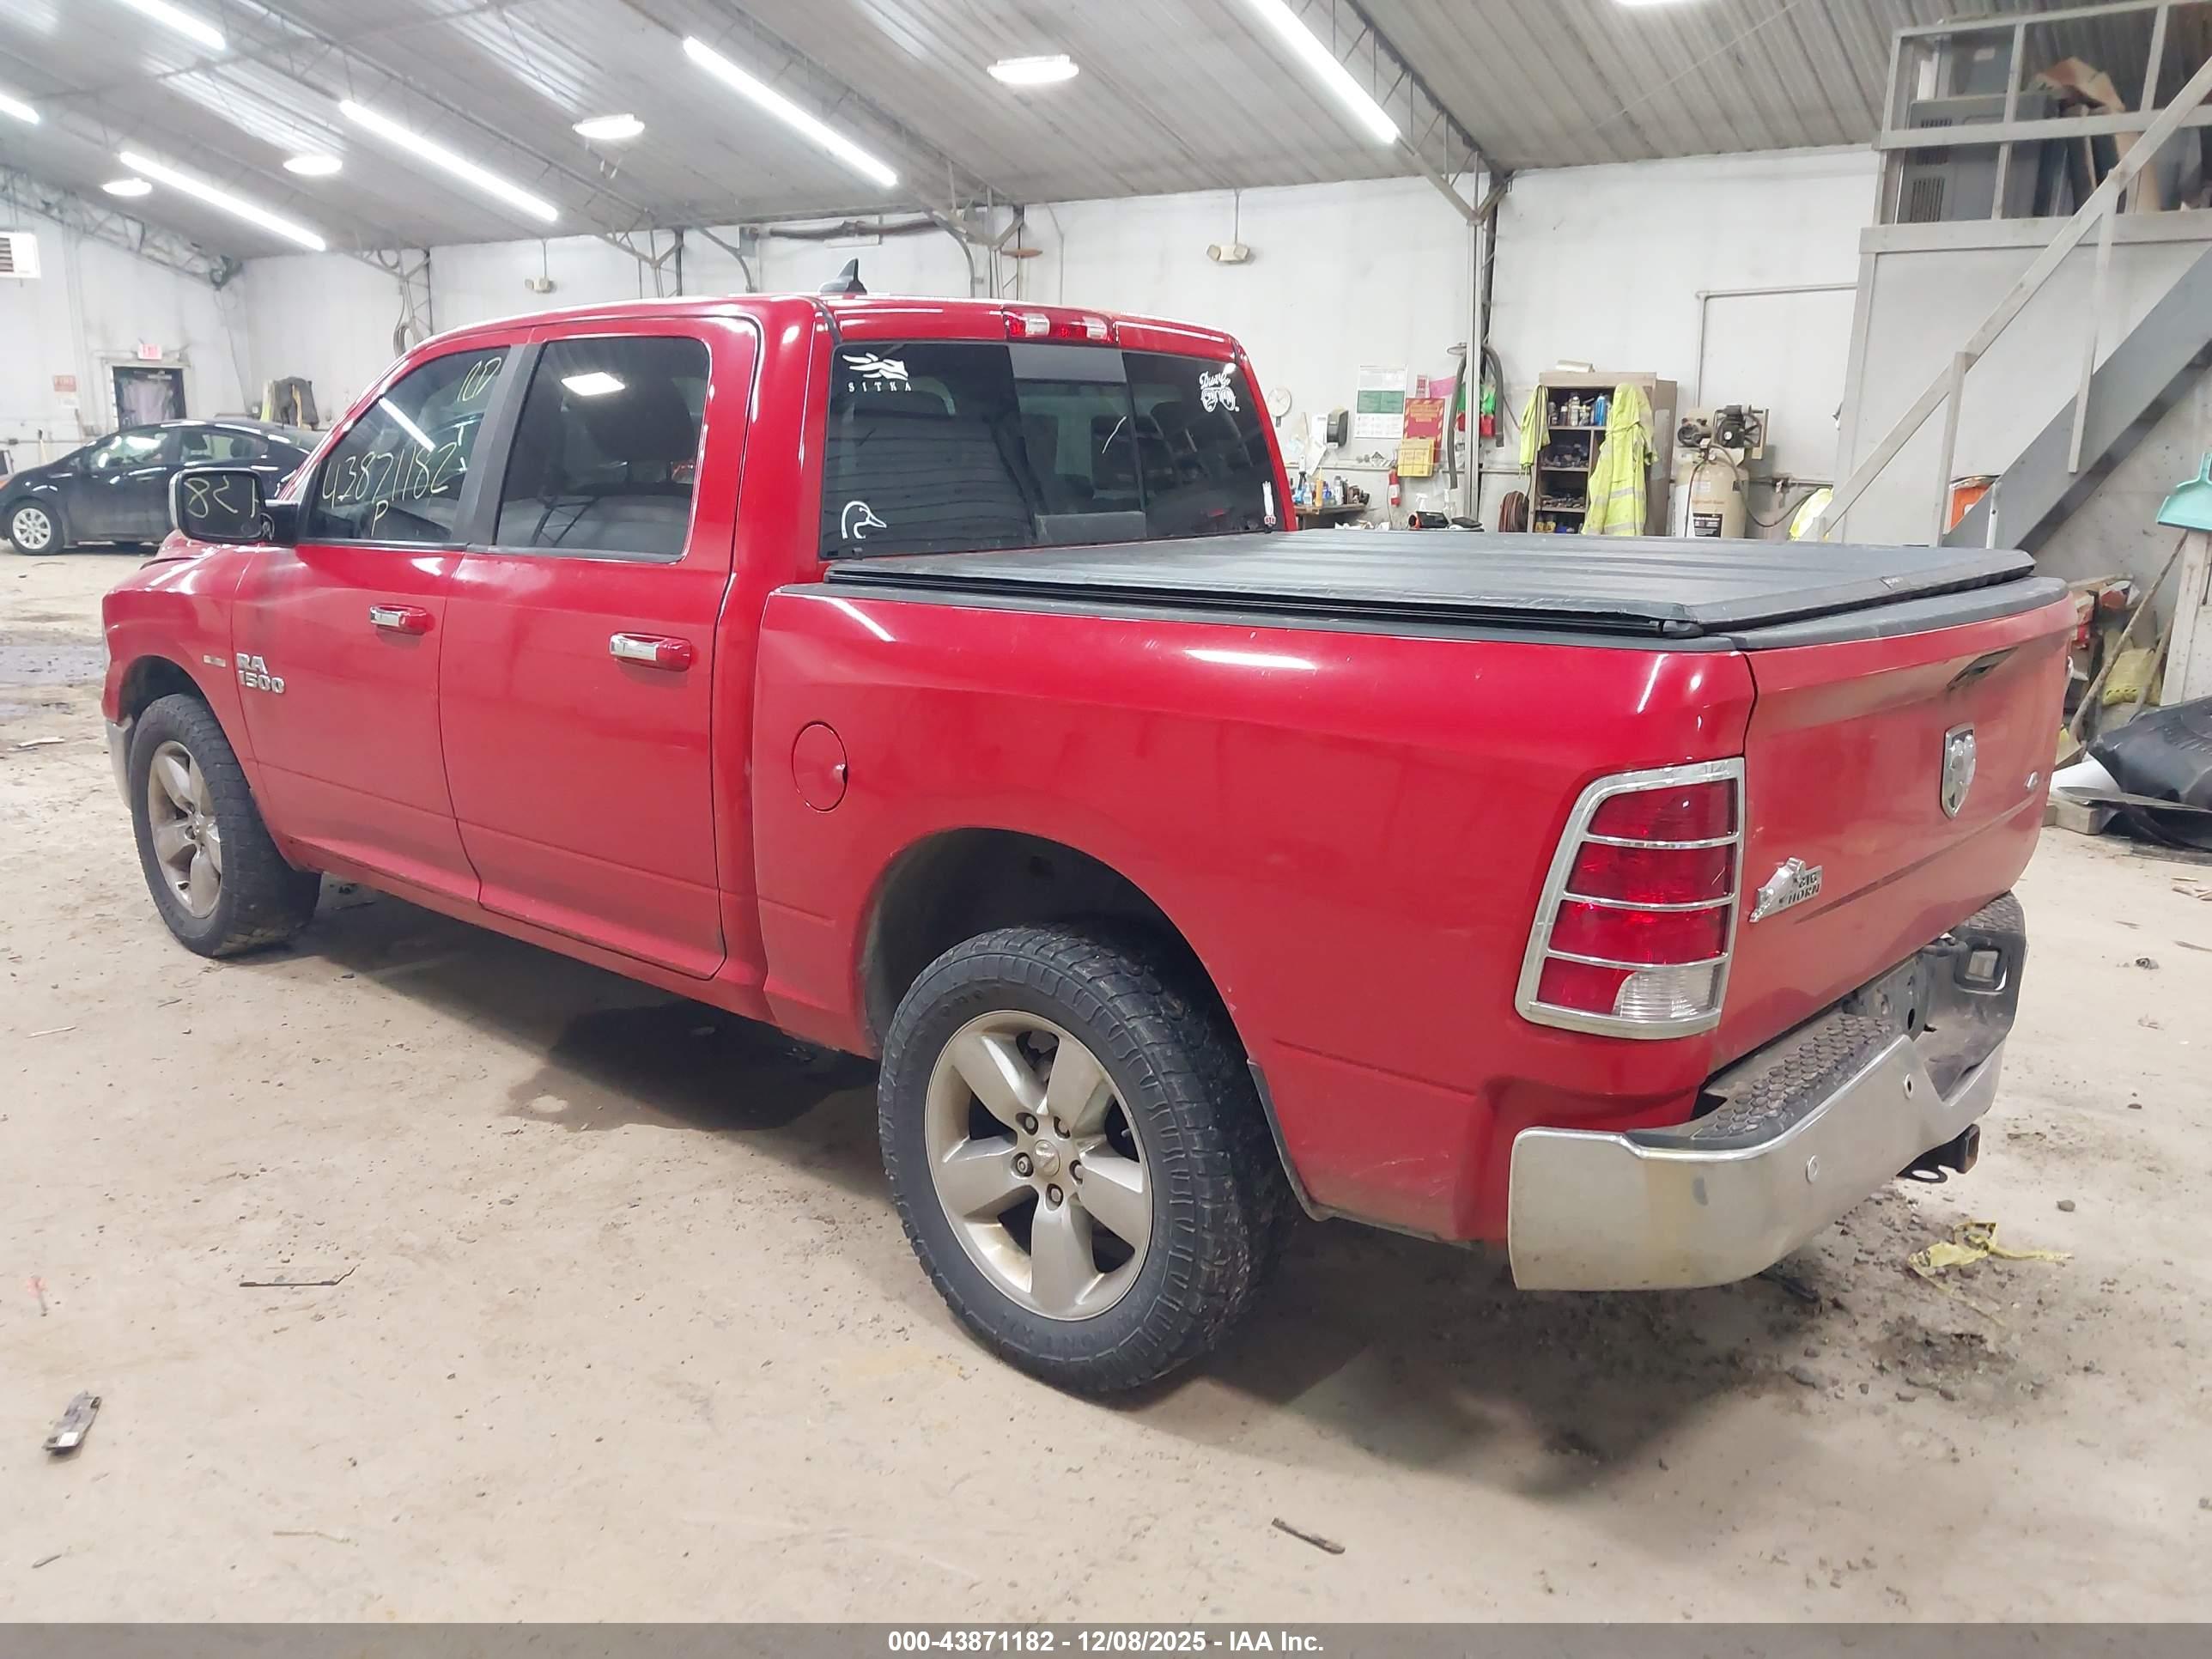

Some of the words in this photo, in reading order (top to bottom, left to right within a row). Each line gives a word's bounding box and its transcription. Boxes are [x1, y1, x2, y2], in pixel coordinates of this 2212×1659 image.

[848, 381, 912, 392] SITKA
[322, 442, 458, 508] 43871182
[371, 500, 389, 536] P
[238, 670, 285, 694] 1500
[1788, 884, 1820, 904] HORN
